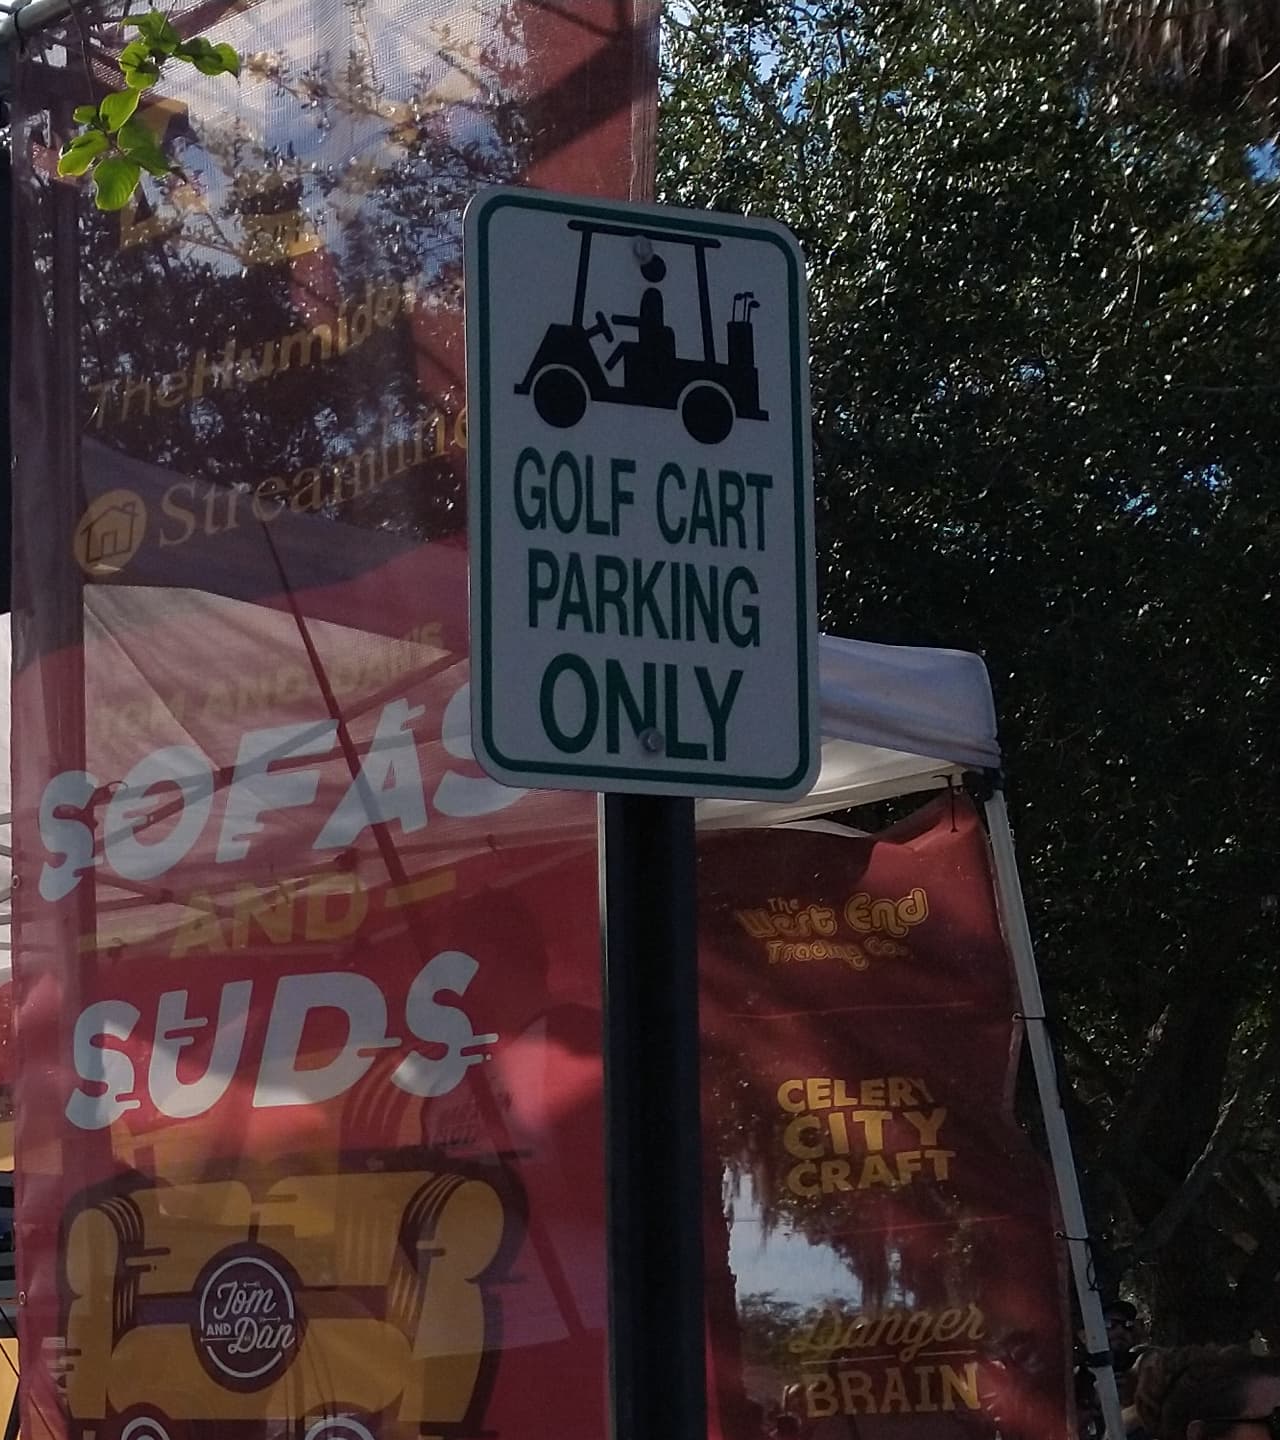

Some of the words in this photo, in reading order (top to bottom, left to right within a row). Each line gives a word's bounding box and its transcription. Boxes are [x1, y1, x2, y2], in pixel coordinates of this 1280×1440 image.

[513, 447, 636, 536] GOLF
[656, 462, 773, 552] CART
[528, 549, 760, 648] PARKING
[540, 652, 744, 762] ONLY
[38, 681, 532, 901] SOFAS
[171, 873, 369, 957] AND
[737, 904, 839, 938] West
[844, 887, 929, 938] End
[768, 897, 800, 914] The
[766, 940, 870, 972] Trading
[65, 951, 499, 1130] SUDS
[777, 1077, 939, 1113] CELERY
[783, 1108, 948, 1160] CITY
[788, 1149, 957, 1199] CRAFT
[213, 1281, 277, 1319] Tom
[206, 1323, 231, 1336] AND
[227, 1317, 295, 1354] Dan
[789, 1301, 986, 1363] Danger
[802, 1362, 982, 1418] BRAIN
